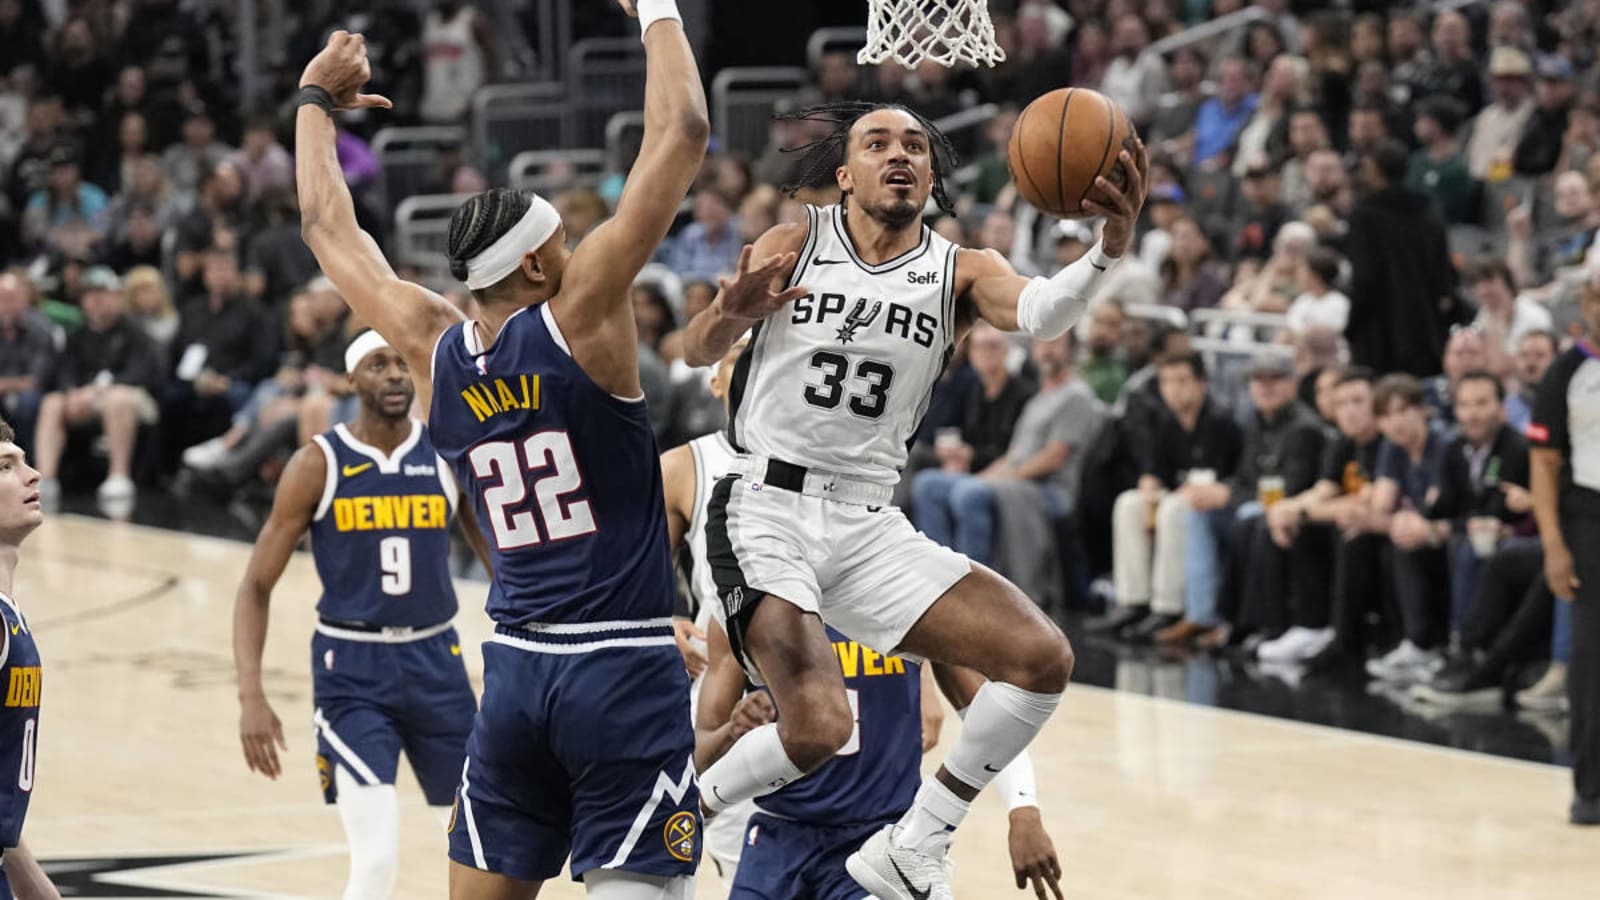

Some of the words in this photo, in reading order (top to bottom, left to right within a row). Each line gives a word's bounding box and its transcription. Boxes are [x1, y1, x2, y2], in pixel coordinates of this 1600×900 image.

[907, 271, 939, 284] Self.
[791, 292, 938, 349] SPURS
[803, 350, 896, 420] 33
[333, 494, 448, 532] DENVER
[469, 430, 598, 550] 22
[380, 536, 411, 595] 9
[4, 666, 42, 708] DEN
[831, 640, 905, 678] VER
[18, 718, 35, 792] 0
